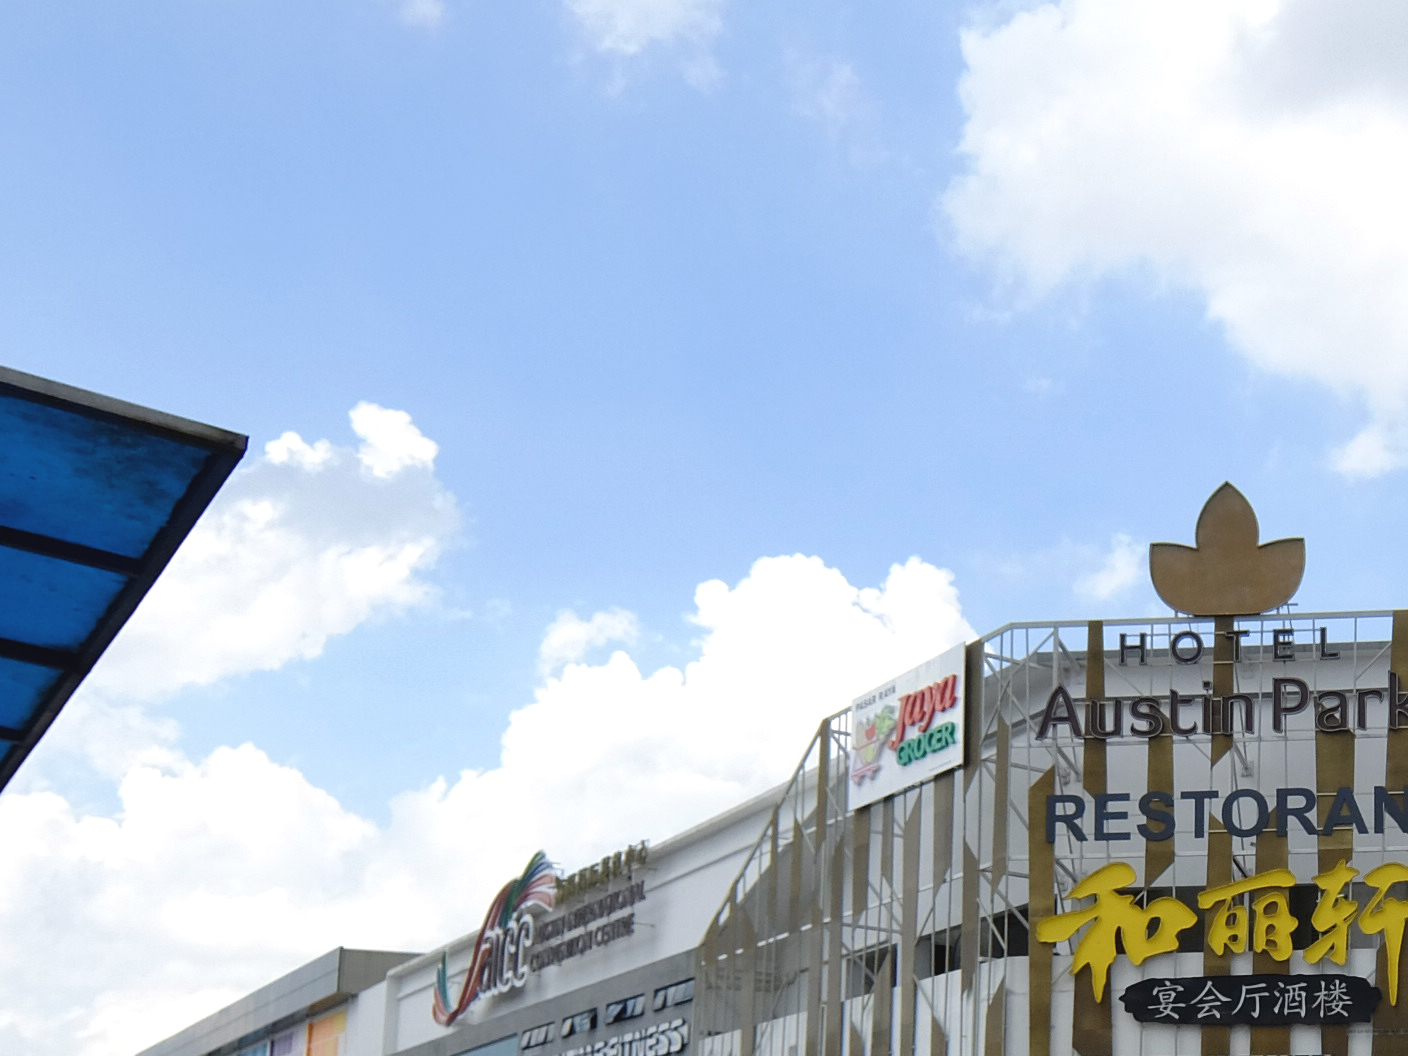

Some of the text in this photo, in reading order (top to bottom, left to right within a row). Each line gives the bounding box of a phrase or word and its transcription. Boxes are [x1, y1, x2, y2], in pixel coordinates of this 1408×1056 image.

[1119, 627, 1341, 666] HOTEL
[887, 673, 957, 751] Jaya
[1035, 680, 1255, 741] Austin
[896, 721, 956, 766] GROCER
[1147, 979, 1354, 1019] 宴会厅酒楼
